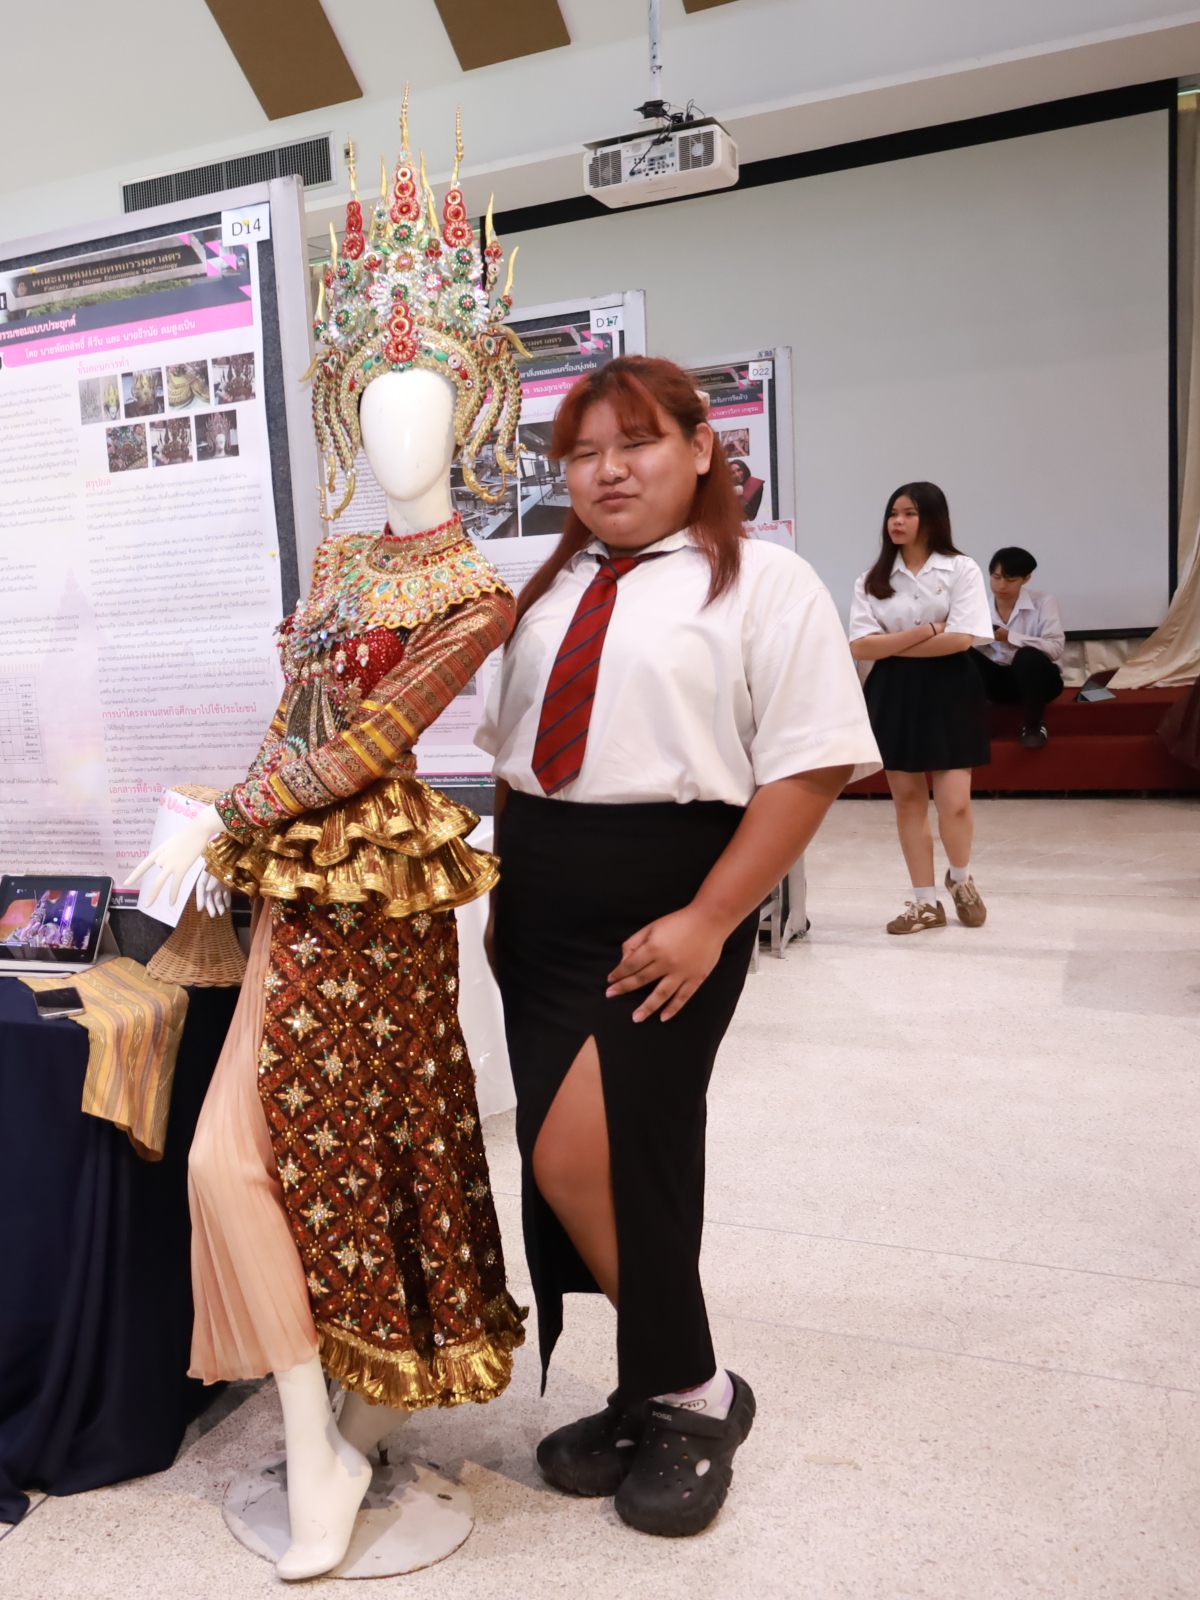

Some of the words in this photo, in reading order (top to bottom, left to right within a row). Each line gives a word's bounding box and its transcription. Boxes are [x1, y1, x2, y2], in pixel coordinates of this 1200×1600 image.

[231, 217, 262, 237] D14
[43, 283, 69, 293] Faculty
[82, 277, 101, 286] Home
[104, 269, 140, 282] Economics
[141, 262, 179, 276] Technology
[596, 315, 619, 328] D17
[25, 348, 38, 359] โดย
[106, 334, 121, 345] และ
[752, 368, 770, 376] D22
[85, 478, 112, 491] สรุปผล
[758, 524, 779, 532] Vote
[102, 701, 257, 719] การนำโครงงานสหกิจศึกษาไปใช้ประโยชน์
[167, 796, 199, 820] Vote
